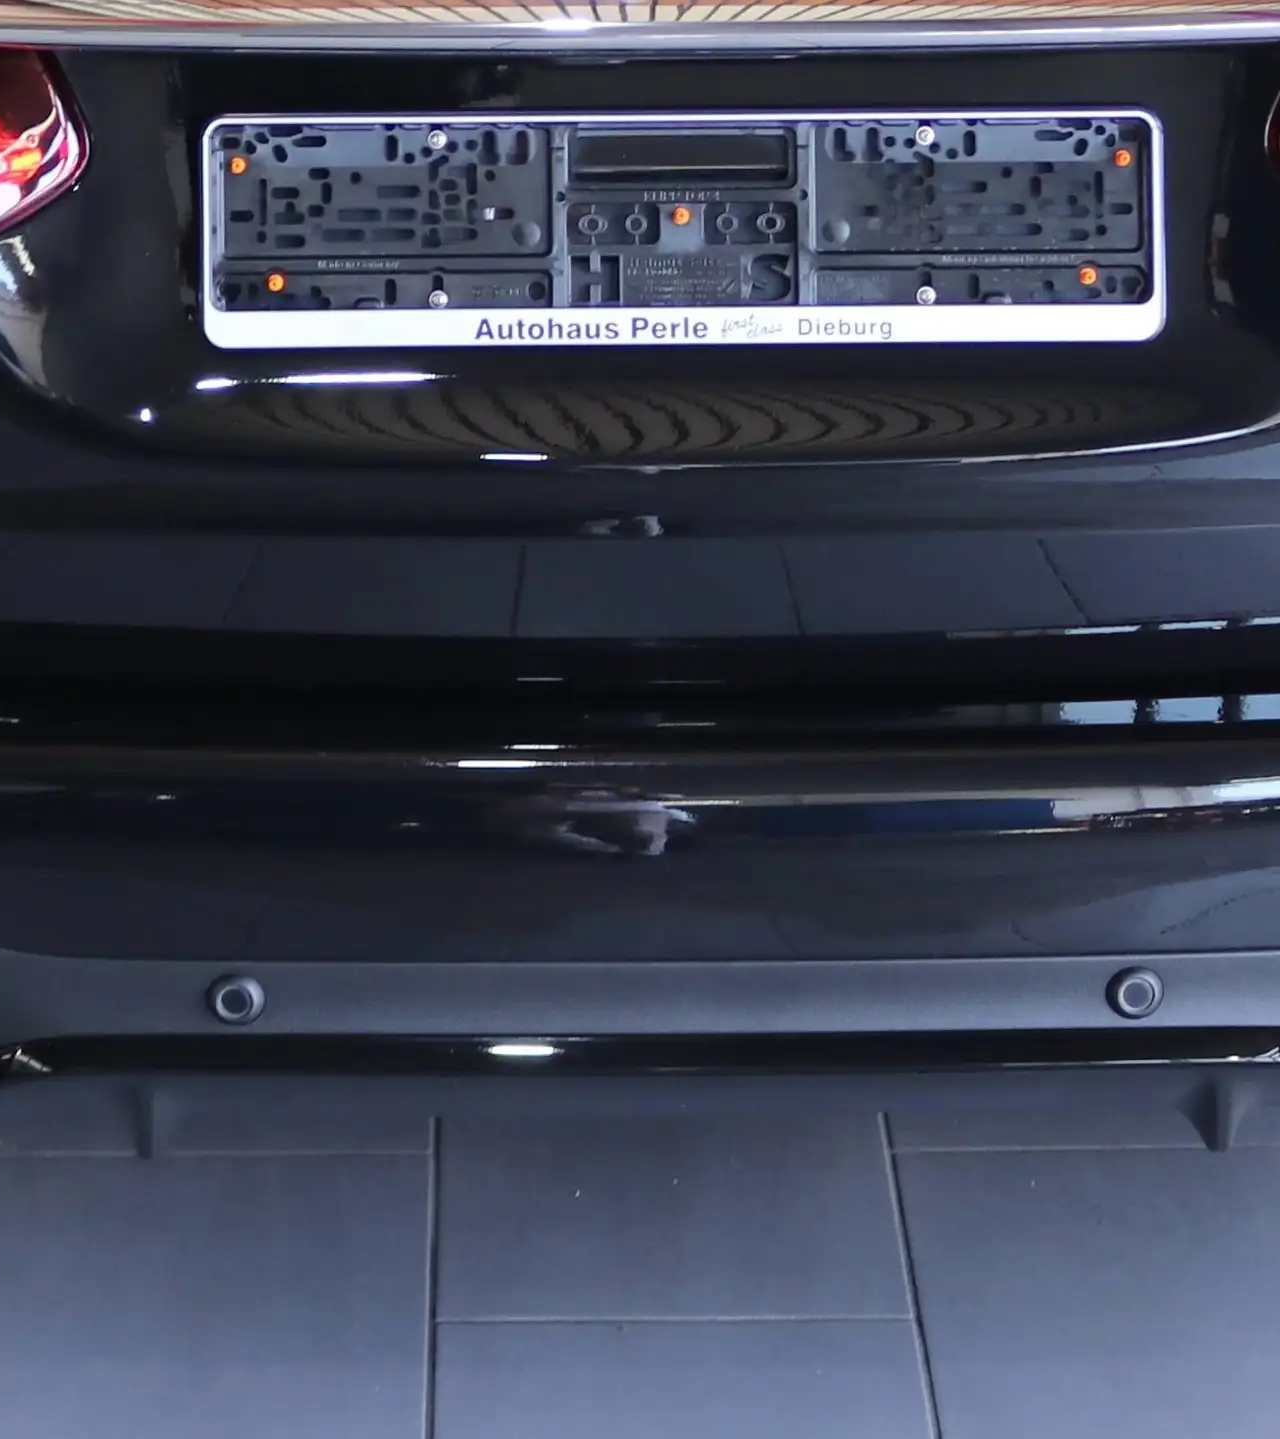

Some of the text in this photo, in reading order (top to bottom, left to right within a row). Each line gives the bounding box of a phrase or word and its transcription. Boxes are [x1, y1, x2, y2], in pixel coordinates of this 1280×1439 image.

[475, 318, 620, 340] Autohaus
[631, 317, 709, 339] Perle
[798, 317, 893, 340] Dieburg
